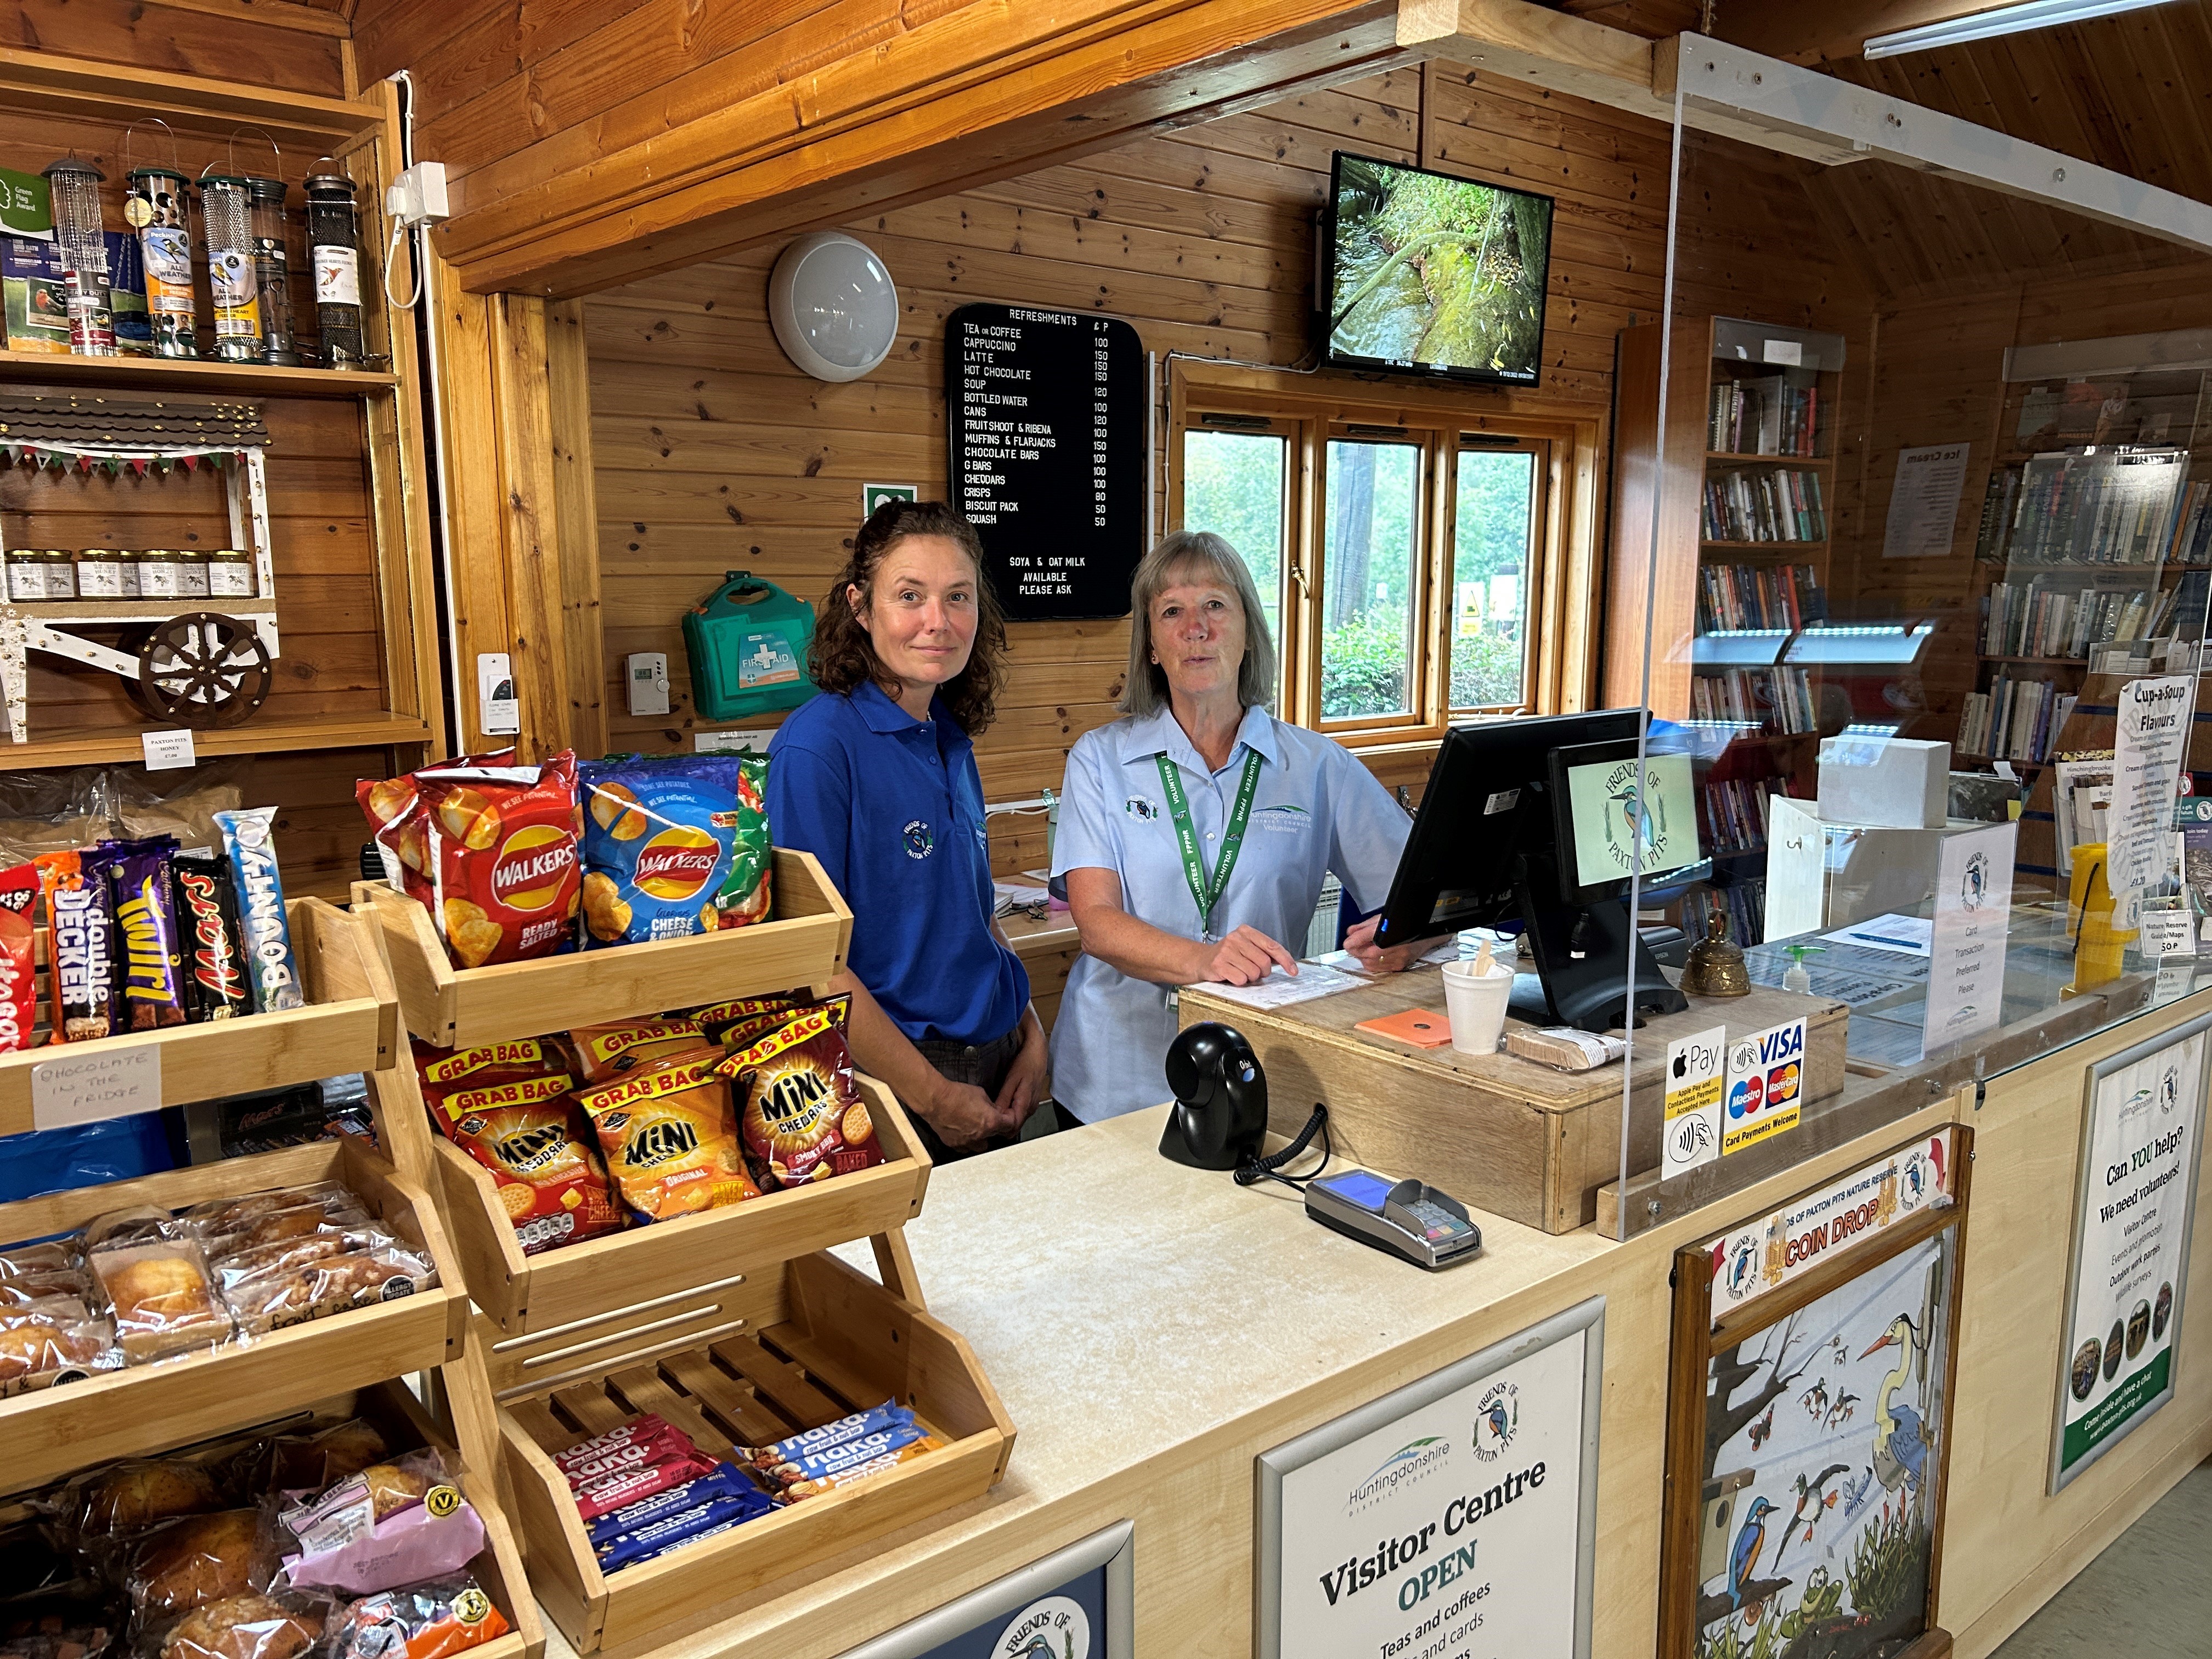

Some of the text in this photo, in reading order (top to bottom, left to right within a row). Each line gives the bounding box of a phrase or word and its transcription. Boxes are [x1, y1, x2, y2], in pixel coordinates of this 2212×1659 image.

[15, 185, 32, 196] Green
[15, 193, 29, 204] Flag
[16, 202, 36, 212] Award
[1009, 308, 1077, 326] REFRESHMENTS
[963, 323, 1022, 339] TEA COFFEE
[963, 337, 1016, 352] CAPPUCCINO
[1094, 337, 1108, 348] 100
[964, 351, 994, 363] LATTE
[1094, 350, 1108, 361] 150
[964, 364, 1031, 381] HOT CHOCOLATE
[1094, 361, 1108, 371] 150
[964, 379, 986, 390] SOUP
[1094, 372, 1108, 382] 150
[964, 392, 1028, 407] BOTTLED WATER
[1094, 387, 1108, 397] 120
[964, 405, 987, 417] CANS
[1094, 402, 1108, 413] 100
[1018, 423, 1052, 435] & RIBENA
[1094, 415, 1107, 425] 120
[965, 433, 1056, 448] MUFFINS & FLAPJACKS
[1093, 428, 1107, 438] 100
[964, 447, 1040, 460] CHOCOLATE BARS
[1093, 441, 1107, 451] 150
[964, 460, 992, 471] G BARS
[1093, 454, 1107, 464] 100
[964, 473, 1006, 486] CHEDDARS
[1093, 466, 1107, 477] 100
[964, 488, 991, 498] CRISPS
[1093, 479, 1107, 489] 100
[1095, 492, 1106, 501] 80
[965, 500, 1019, 512] BISCUIT PACK
[1095, 504, 1106, 514] 50
[966, 514, 997, 524] SQUASH
[1094, 517, 1105, 527] 50
[1009, 556, 1086, 567] SOYA & OAT MILK
[1023, 572, 1067, 582] AVAILABLE
[1019, 585, 1072, 595] PLEASE ASK
[772, 653, 789, 664] AID
[2134, 685, 2186, 707] Cup-a-Soup
[2140, 714, 2176, 732] Flavours
[1244, 753, 1259, 793] VOLUNTEER
[1647, 771, 1661, 789] OF
[1164, 764, 1180, 805] VOLUNTEER
[1235, 798, 1248, 822] FPPNR
[1262, 822, 1299, 834] Volunteer
[1182, 829, 1194, 855] FPPNR
[1647, 834, 1668, 867] PITS
[496, 844, 575, 888] WALKERS
[640, 853, 718, 875] WALKERS
[1214, 849, 1233, 894] VOLUNTEER
[1189, 861, 1206, 907] VOLUNTEER
[240, 850, 292, 989] BOUNTY
[522, 918, 558, 939] READY
[651, 915, 695, 932] CHEESE
[116, 874, 182, 1002] Twirl
[179, 871, 245, 999] Mars
[519, 927, 558, 950] SALTED
[1965, 924, 1978, 937] Card
[54, 889, 91, 1006] DECKER
[85, 907, 112, 1003] double
[1955, 942, 1985, 959] Transaction
[1955, 960, 1980, 977] Preferred
[1957, 981, 1975, 995] Please
[719, 1015, 823, 1076] GRAB BAG
[1757, 1024, 1802, 1065] VISA
[40, 1054, 148, 1082] CHOCOLATE
[438, 1042, 534, 1081] GRAB BAG
[1690, 1045, 1719, 1076] Pay
[86, 1073, 121, 1087] THE
[1767, 1075, 1799, 1094] MasterCard
[74, 1085, 139, 1107] FRIDGE
[456, 1079, 565, 1109] GRAB BAG
[1667, 1086, 1719, 1110] Contactless Payments
[1677, 1084, 1702, 1098] Apple Pay
[1731, 1088, 1761, 1108] Maestro
[1676, 1097, 1710, 1116] Accepted Here
[1725, 1112, 1798, 1148] Card Payments Welcome
[794, 1146, 823, 1165] SMOKY
[836, 1152, 868, 1172] BAKED
[2106, 1125, 2183, 1187] Can YOU help?
[665, 1167, 709, 1187] ORIGINAL
[1795, 1165, 1898, 1224] OF PAXTON PITS NATURE RESERVE
[2100, 1159, 2180, 1223] We need volunteers!
[1784, 1197, 1879, 1268] COIN DROP
[2123, 1217, 2141, 1238] Visitor
[2109, 1265, 2130, 1288] Outdoor
[385, 1282, 412, 1295] ALLERGY
[269, 1295, 378, 1331] fruit cake
[1477, 1381, 1519, 1412] FRIENDS OF
[1472, 1427, 1517, 1463] PAXTON PITS
[1349, 1441, 1451, 1506] Huntingdonshire
[1349, 1460, 1449, 1518] DISTRICT COUNCIL
[1319, 1460, 1546, 1606] Visitor Centre
[1398, 1538, 1478, 1611] OPEN
[1380, 1582, 1491, 1659] Teas and coffees
[1449, 1612, 1483, 1644] cards
[1005, 1610, 1071, 1654] FRIENDS OF
